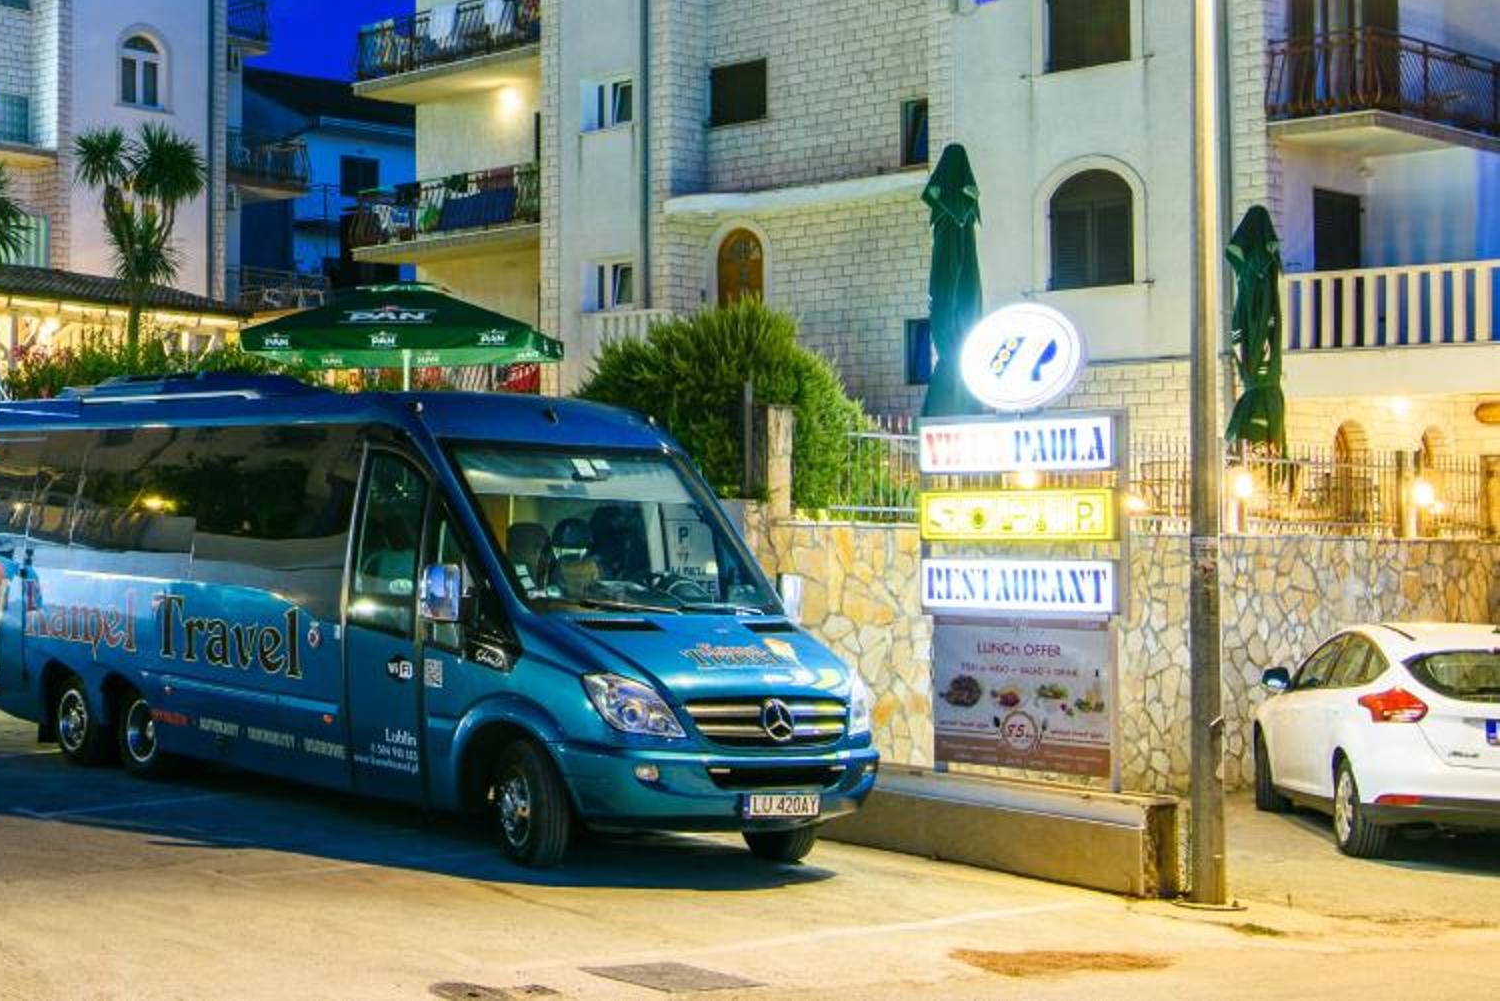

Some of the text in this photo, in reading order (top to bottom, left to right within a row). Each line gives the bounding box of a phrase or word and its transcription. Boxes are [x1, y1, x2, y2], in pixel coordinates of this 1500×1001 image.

[348, 311, 426, 322] PAN
[925, 426, 1106, 466] VIL PAULA
[927, 566, 1107, 604] RESTAURANT
[152, 594, 303, 679] Travel
[977, 639, 1061, 658] LUNCH OFFER
[385, 728, 417, 747] Lublin
